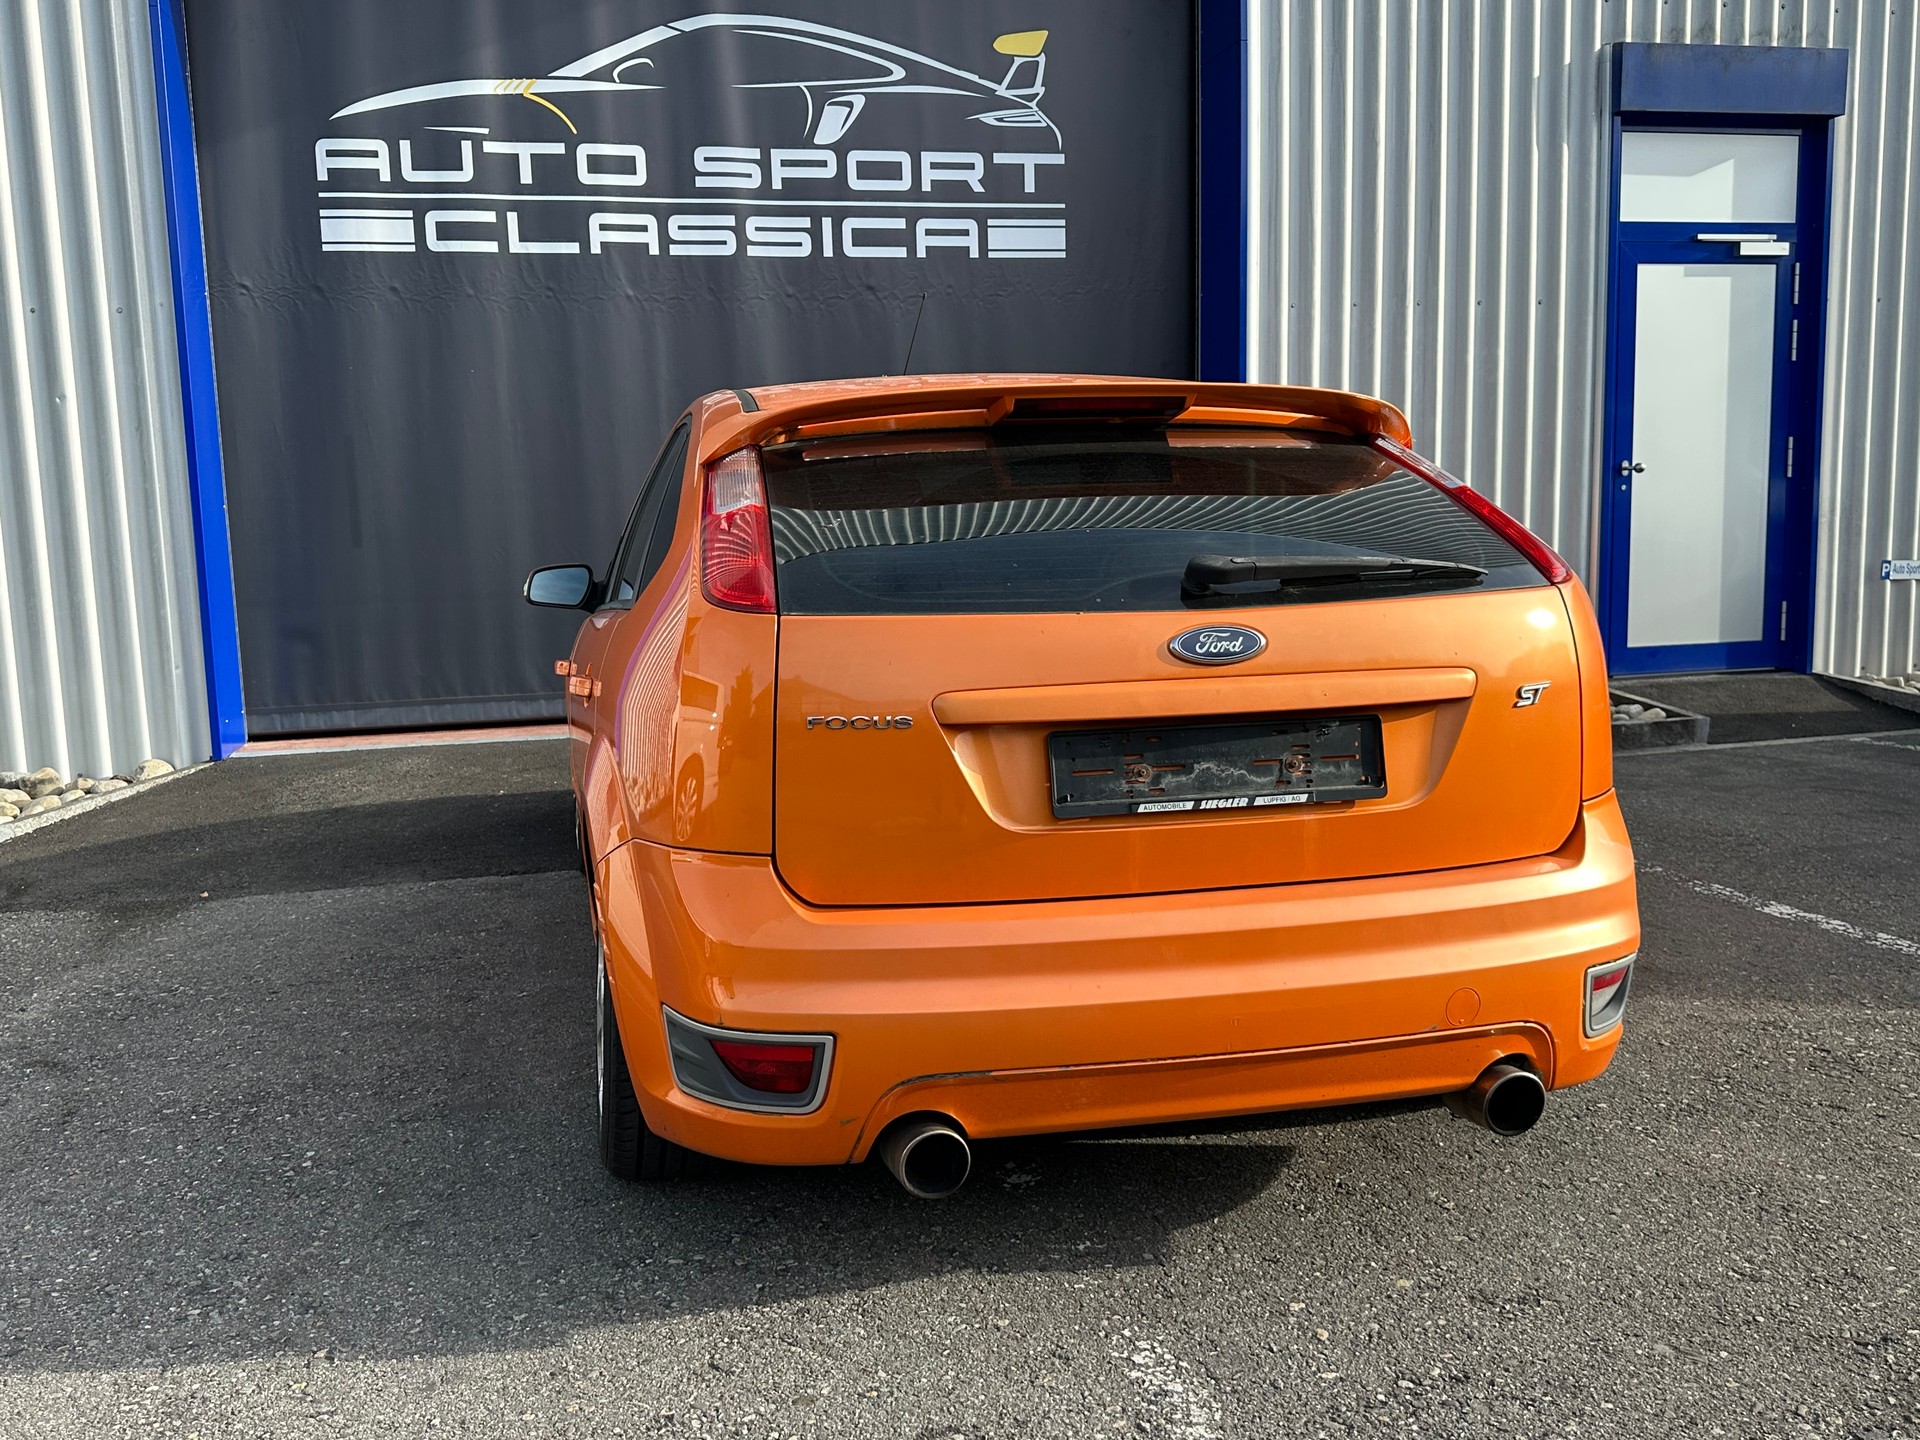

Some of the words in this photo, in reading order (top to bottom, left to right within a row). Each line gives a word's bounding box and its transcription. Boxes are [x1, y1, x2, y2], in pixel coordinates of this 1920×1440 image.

[315, 138, 647, 186] AUTO
[694, 146, 1065, 193] SPORT
[425, 210, 979, 258] CLASSICA
[1892, 563, 1905, 574] Auto
[1195, 632, 1244, 653] Ford
[1511, 679, 1552, 709] ST
[806, 715, 914, 730] FOCUS
[1143, 802, 1187, 811] AUTOMOBILE
[1199, 797, 1249, 809] SIEGLER
[1262, 796, 1287, 804] LUPFIG
